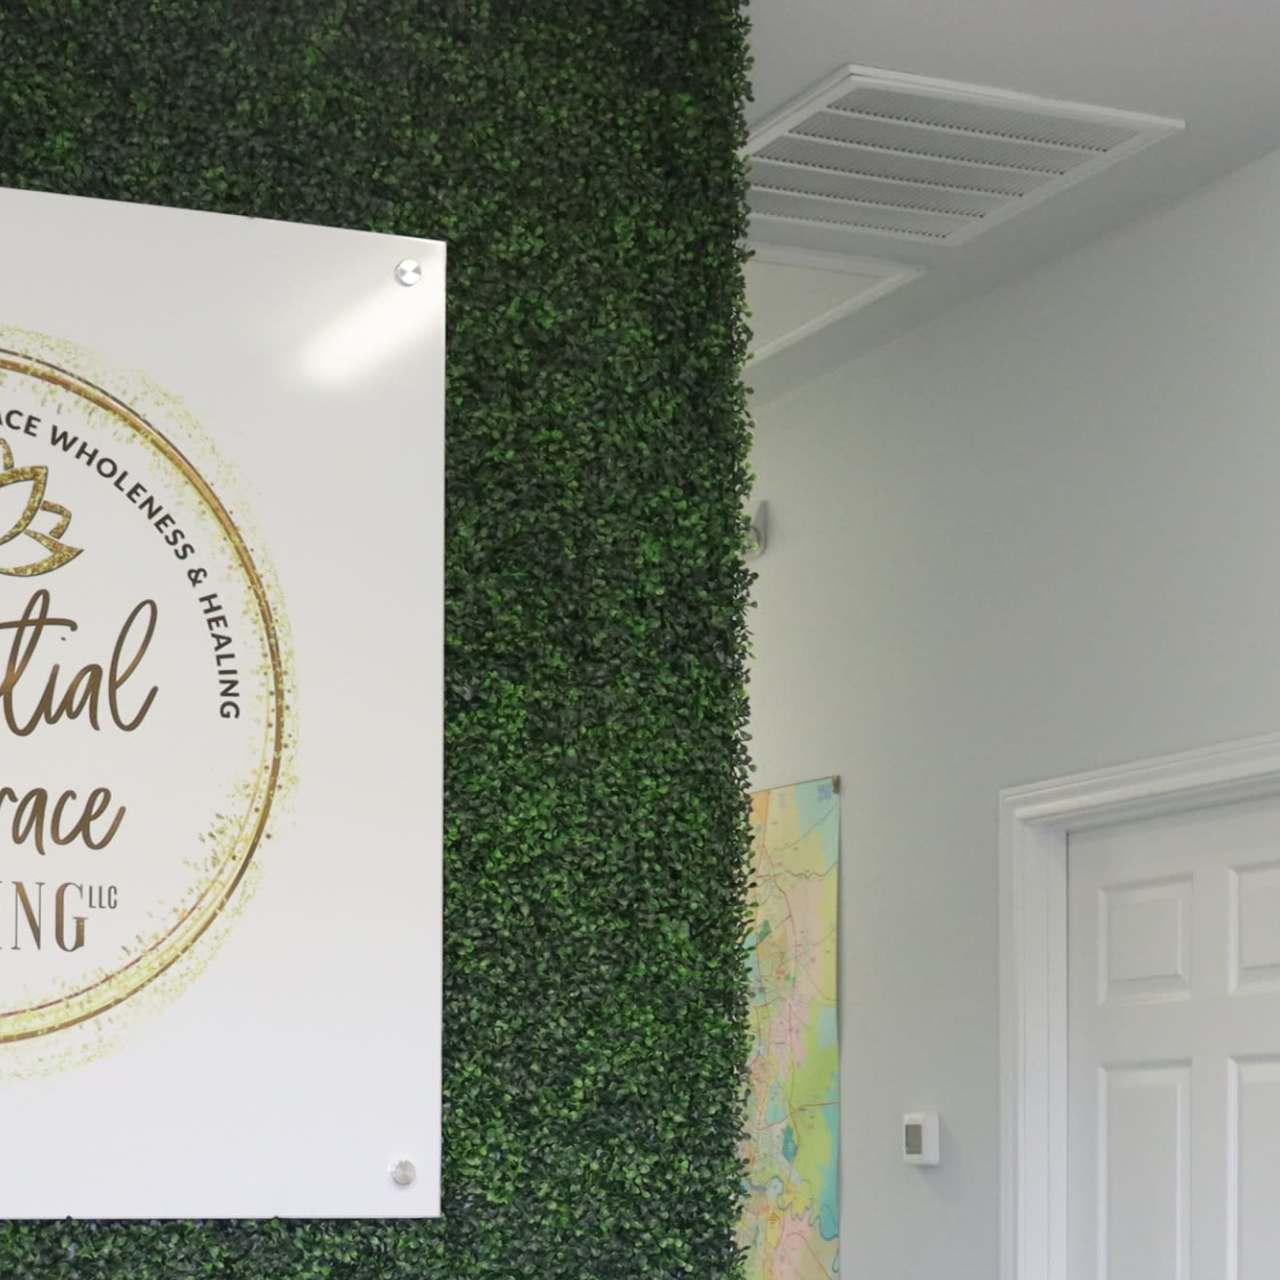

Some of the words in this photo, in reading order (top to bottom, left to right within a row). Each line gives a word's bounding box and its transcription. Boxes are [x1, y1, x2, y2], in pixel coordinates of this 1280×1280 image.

[50, 424, 195, 562] WHOLENESS
[186, 566, 209, 589] &
[198, 593, 241, 720] HEALING
